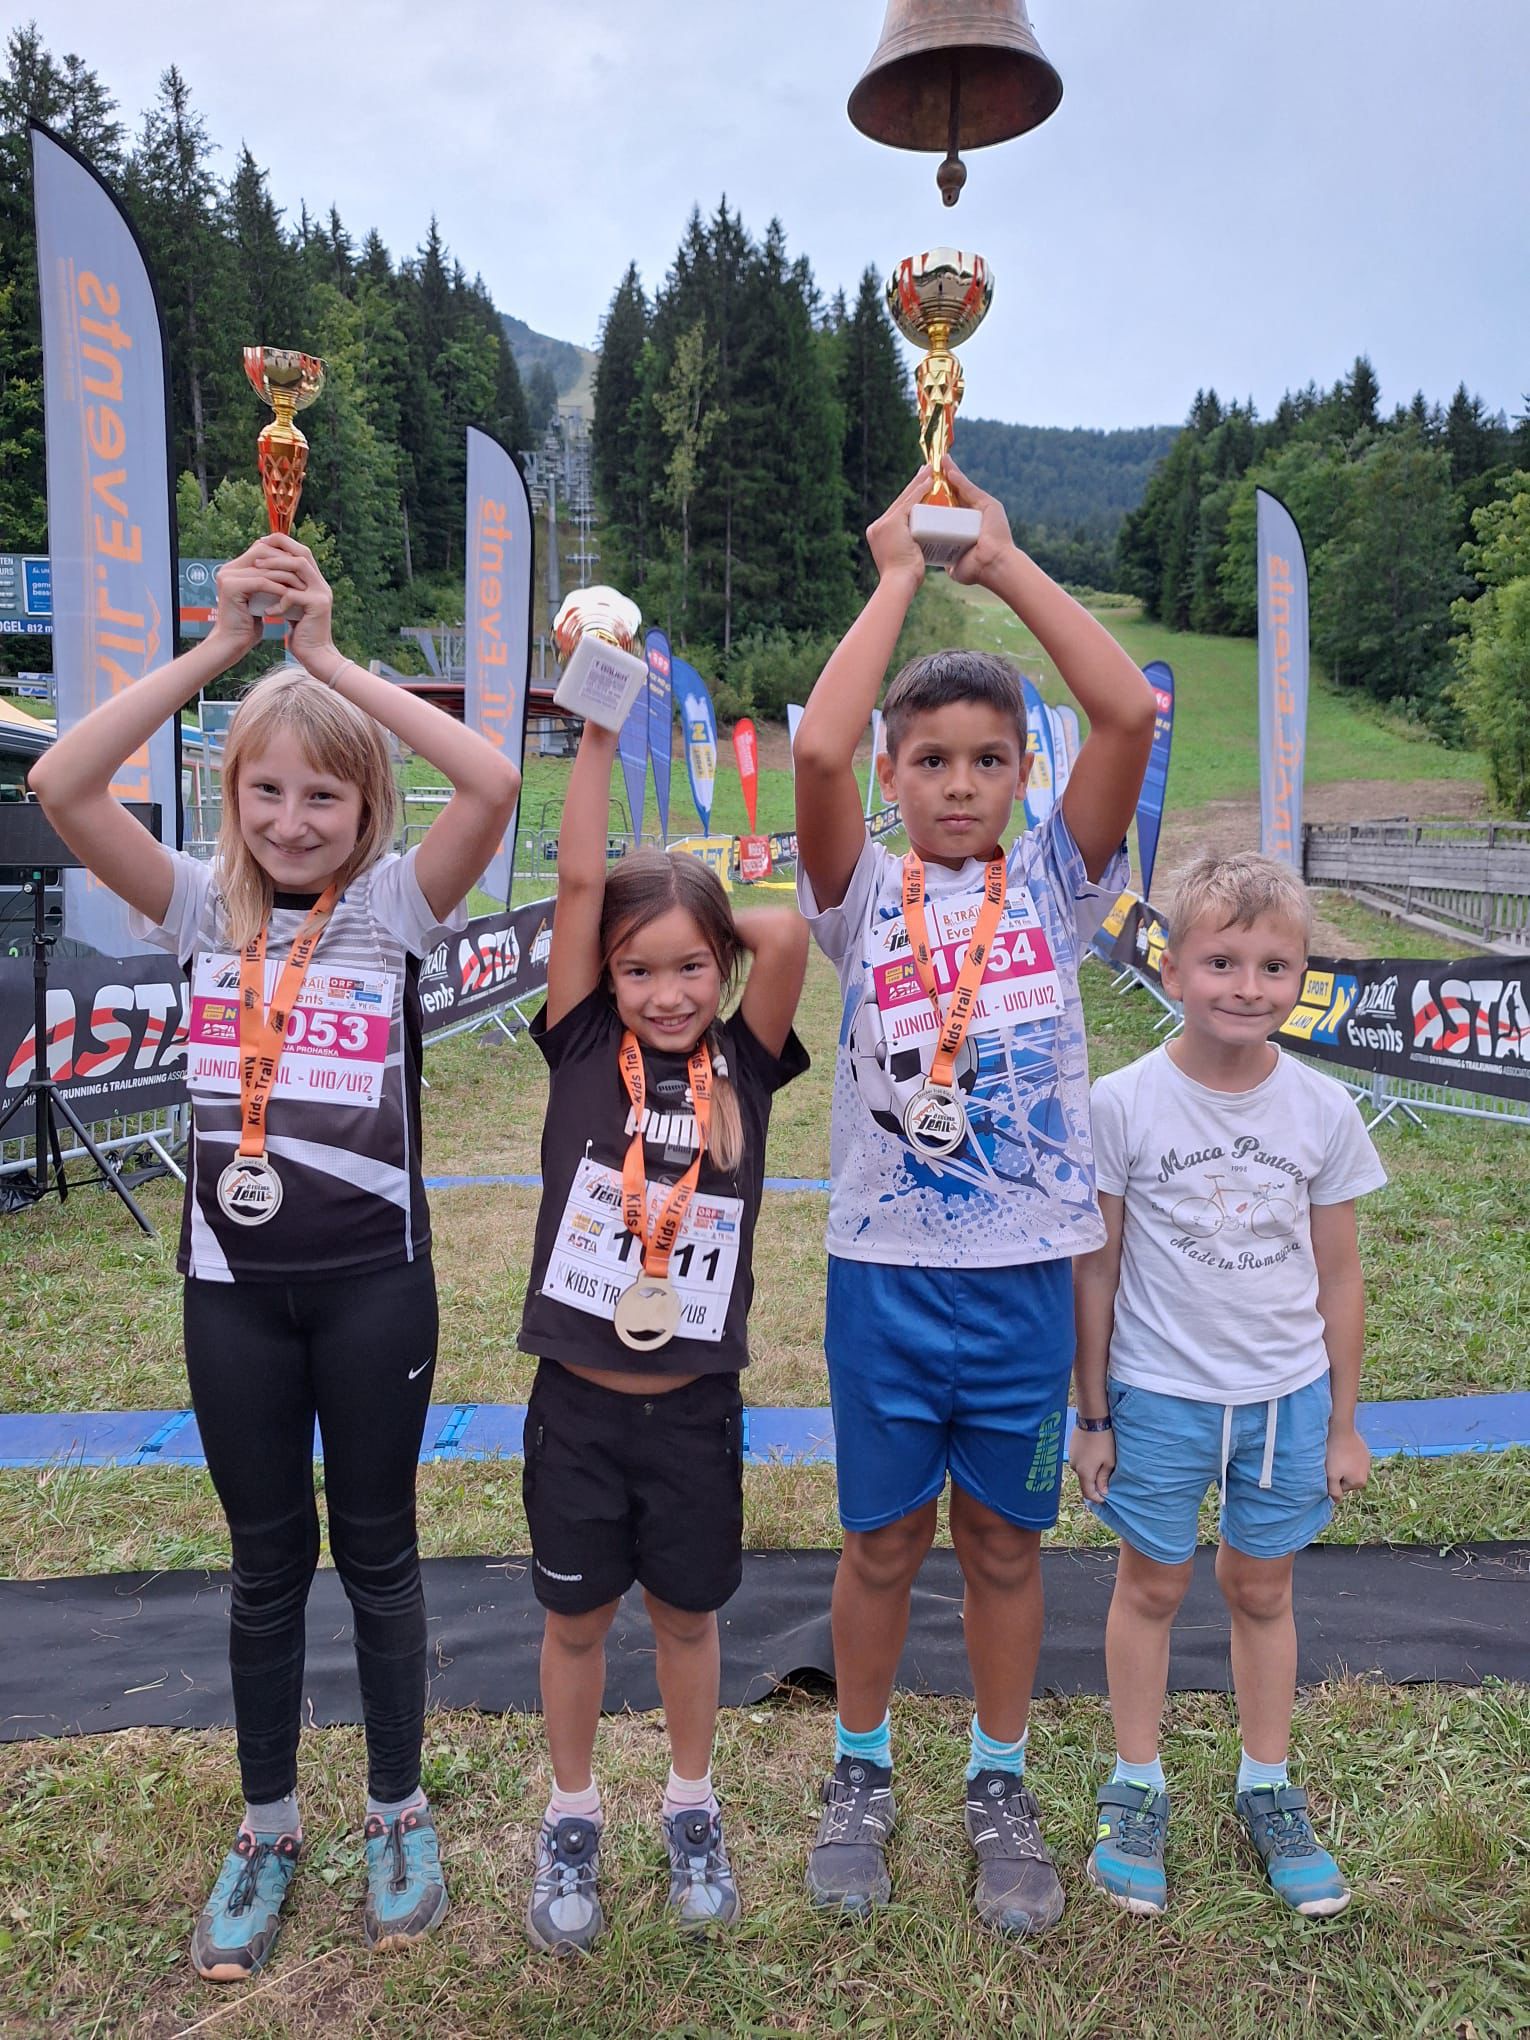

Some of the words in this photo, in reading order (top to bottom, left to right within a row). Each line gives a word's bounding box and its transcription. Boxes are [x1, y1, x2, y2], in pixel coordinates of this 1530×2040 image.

[0, 557, 13, 565] TEN
[0, 567, 14, 576] URS
[0, 621, 25, 633] OGEL
[27, 623, 43, 633] 812
[907, 881, 921, 905] Kids
[987, 879, 1002, 905] Kids
[290, 939, 313, 969] Kids
[458, 925, 521, 996] ASTA
[296, 993, 324, 1006] ents
[330, 979, 354, 990] ORF
[1003, 984, 1057, 1013] U10/U12
[1306, 979, 1329, 997] SPORT
[951, 987, 974, 1018] Trail
[285, 1009, 369, 1052] 053
[940, 1016, 964, 1054] Kids
[1289, 1014, 1313, 1030] LAND
[1346, 1018, 1405, 1054] Events
[1411, 979, 1530, 1063] ASTA
[296, 1045, 340, 1057] PROHASKA
[621, 1045, 639, 1072] Trail
[102, 1080, 109, 1093] &
[110, 1073, 168, 1092] TRAILRUNNING
[194, 1056, 240, 1080] JUNIO
[309, 1064, 374, 1094] U10/U12
[255, 1056, 276, 1091] Trail
[694, 1071, 711, 1101] Trail
[632, 1074, 643, 1104] Kids
[248, 1094, 264, 1126] Kids
[624, 1105, 709, 1150] PUM
[1158, 1146, 1226, 1184] Marco
[1231, 1135, 1308, 1186] Pantani
[626, 1193, 642, 1227] Kids
[655, 1217, 677, 1252] Kids
[666, 1185, 693, 1215] Trail
[698, 1207, 717, 1219] ORF
[568, 1232, 598, 1254] ASTA
[613, 1229, 721, 1283] 111
[1170, 1236, 1216, 1266] Made
[1217, 1258, 1236, 1270] in
[1237, 1241, 1302, 1271] Romagna
[565, 1269, 599, 1299] KIDS
[681, 1303, 707, 1325] /U8
